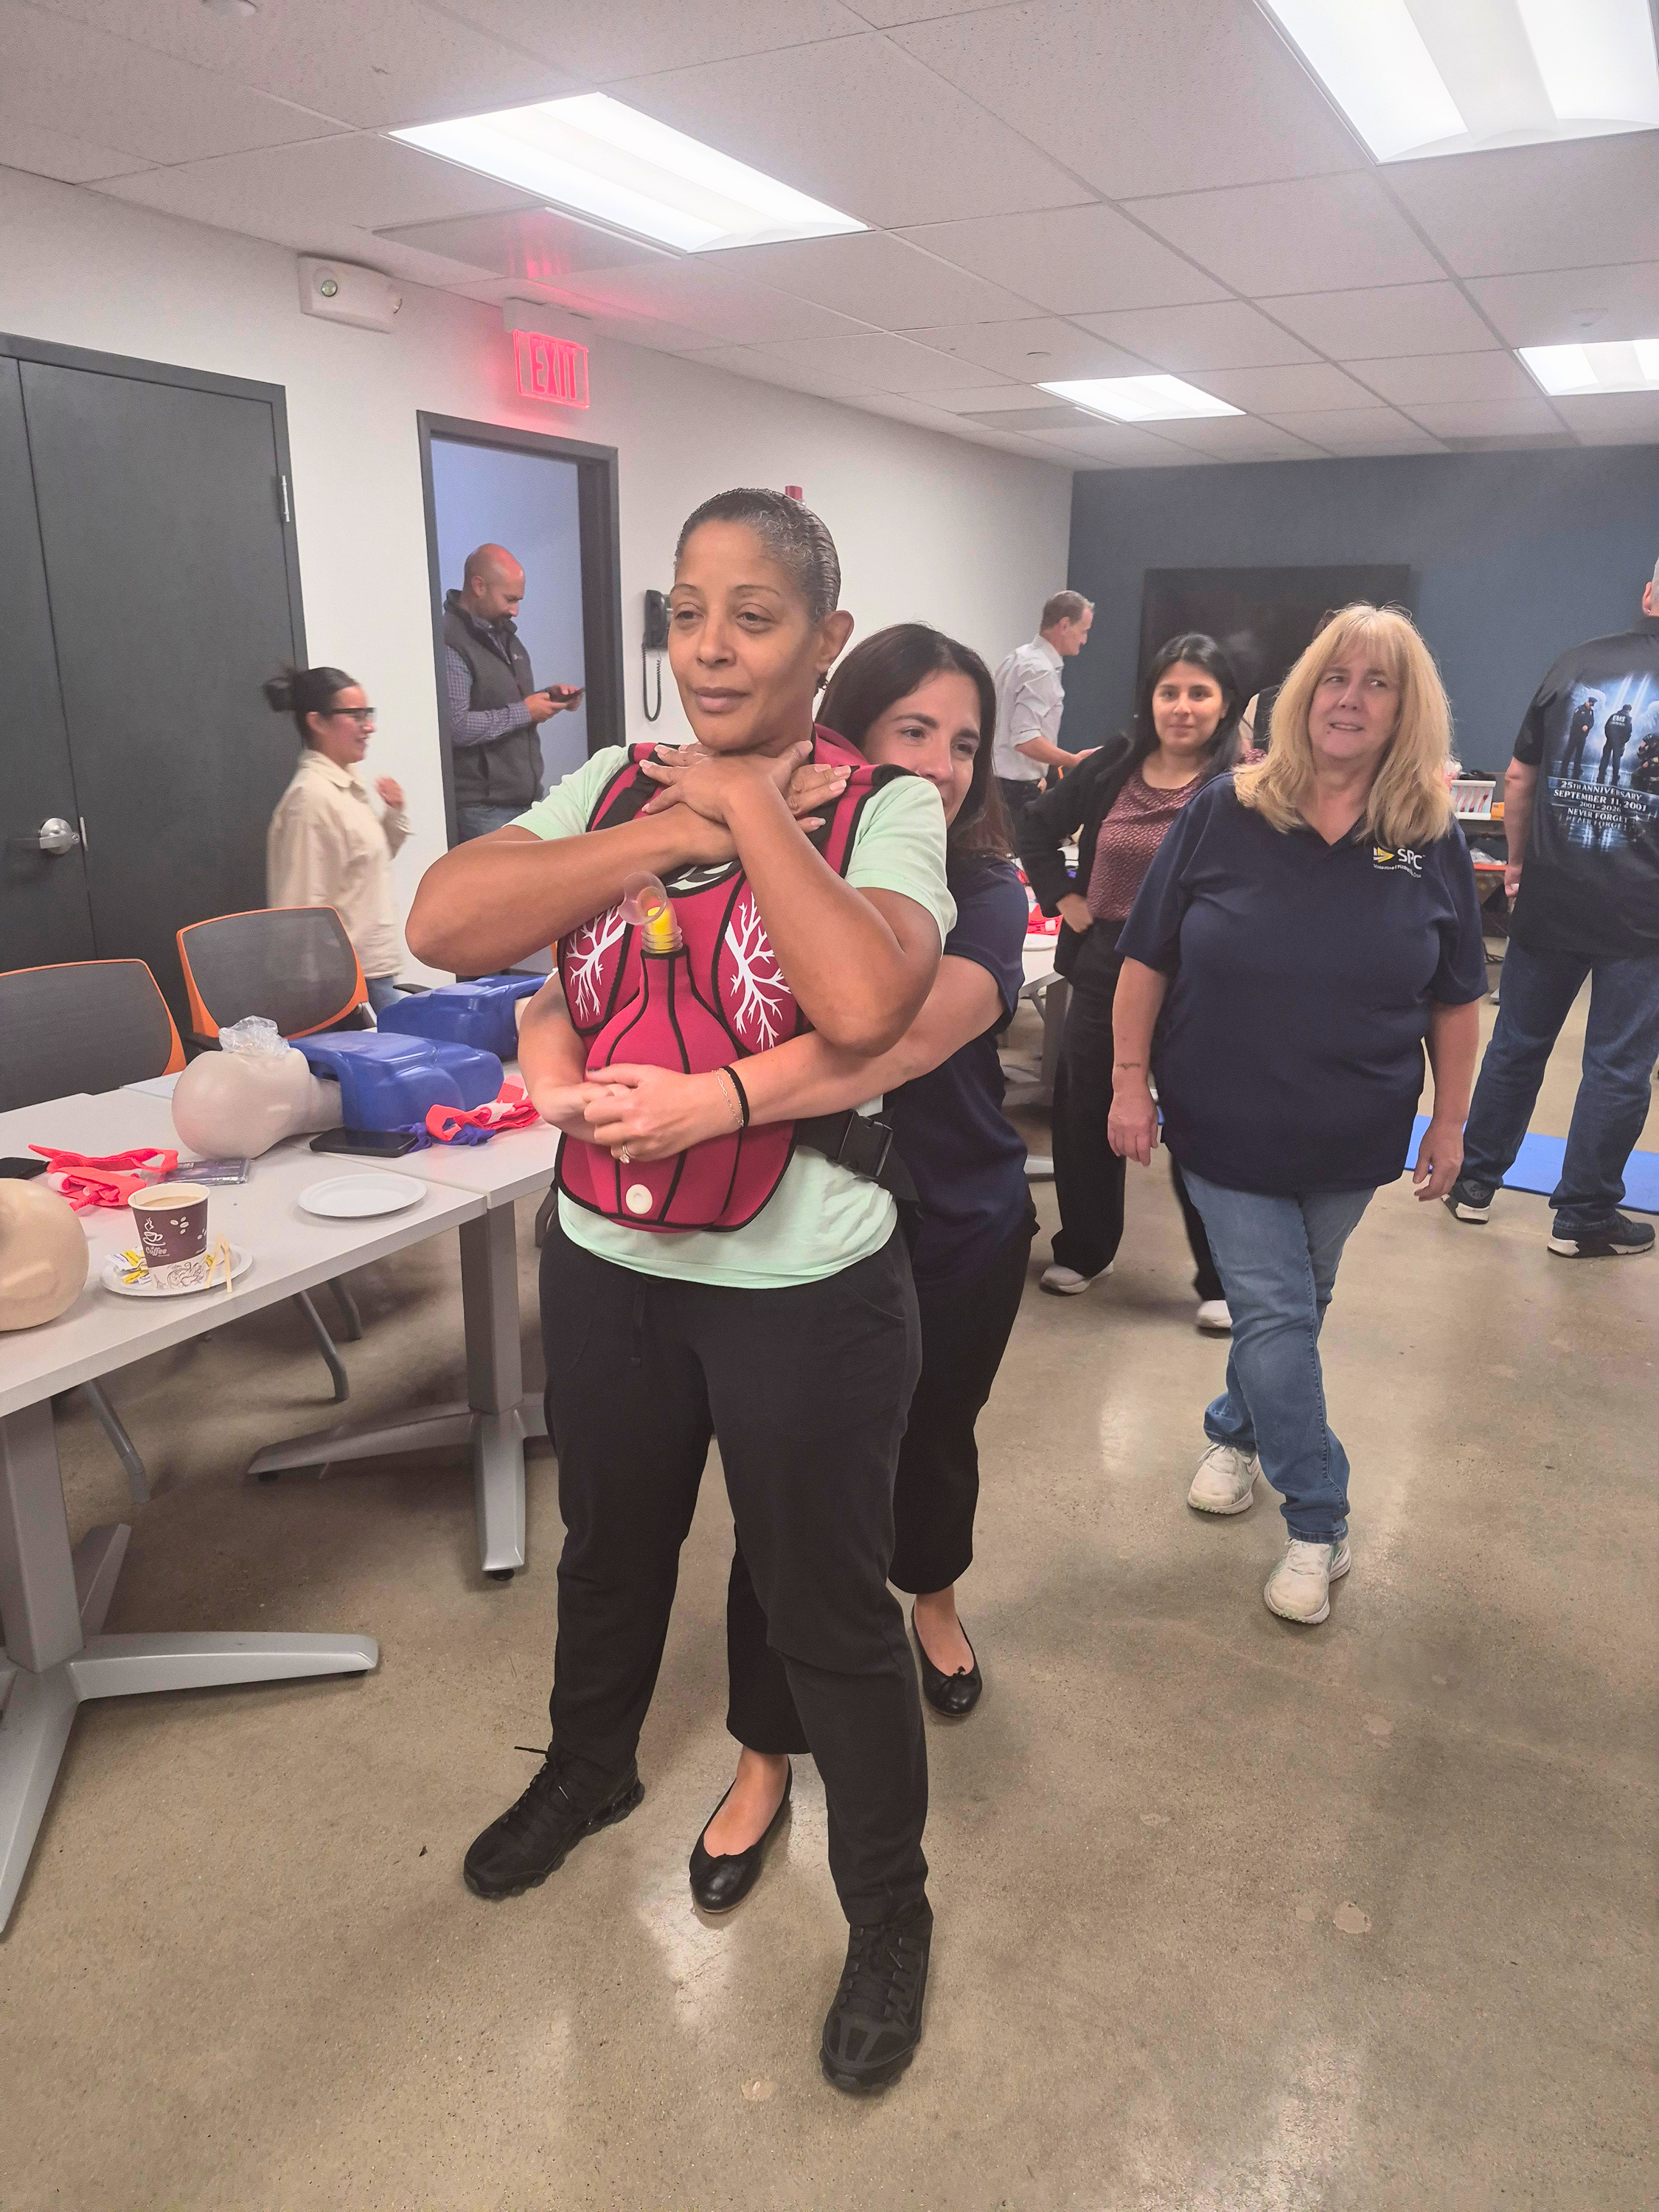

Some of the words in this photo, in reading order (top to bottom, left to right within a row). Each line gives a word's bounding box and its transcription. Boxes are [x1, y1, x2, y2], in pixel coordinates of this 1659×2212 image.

[529, 338, 577, 400] EXIT
[1554, 789, 1607, 804] SEPTEMBER
[1610, 797, 1621, 807] 11,
[1624, 801, 1647, 812] 2001
[1561, 780, 1582, 790] 25TH
[1582, 785, 1643, 801] ANNIVERSARY
[1568, 807, 1593, 818] NEVER
[1595, 813, 1628, 824] FORGET
[1397, 848, 1423, 870] SPC
[145, 1246, 167, 1256] Coffee
